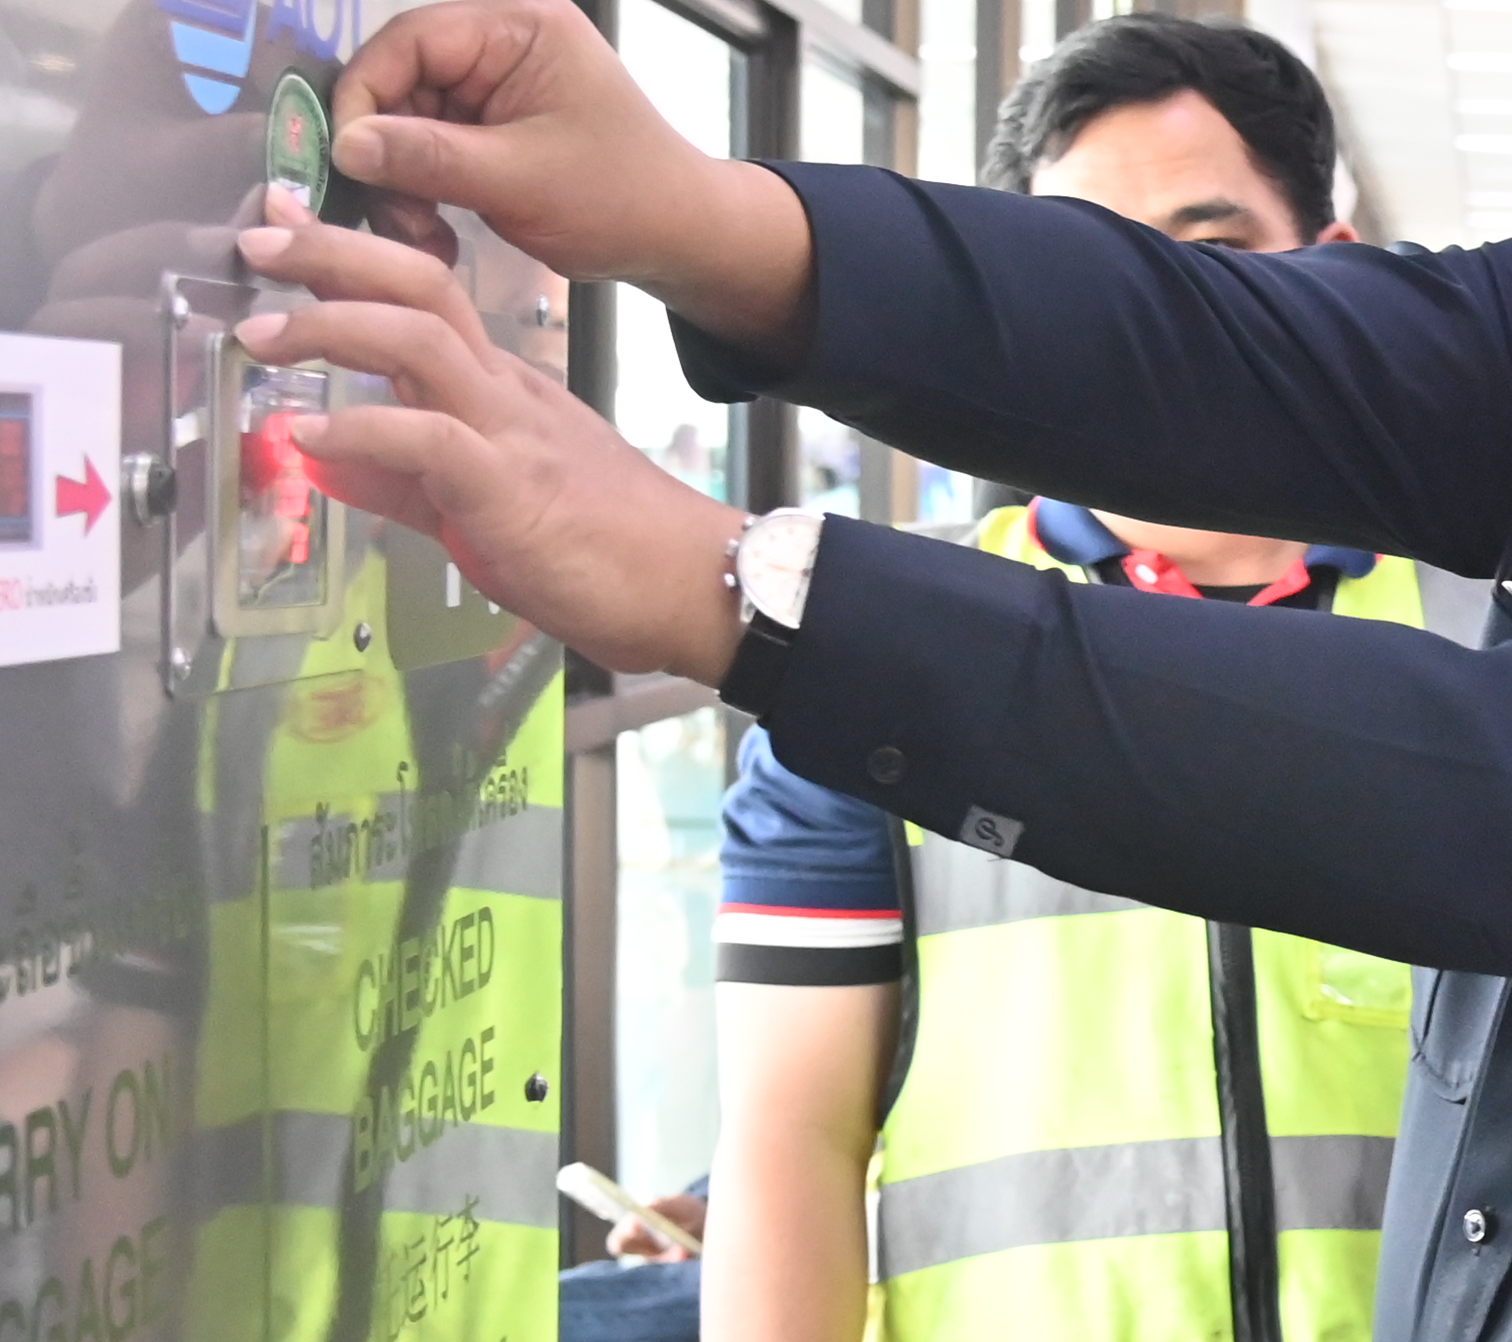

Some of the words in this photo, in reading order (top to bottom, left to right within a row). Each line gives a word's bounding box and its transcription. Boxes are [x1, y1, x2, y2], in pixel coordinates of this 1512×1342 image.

[353, 906, 495, 1052] CHECKED
[106, 1054, 175, 1179] ON
[353, 1025, 496, 1194] BAGGAGE
